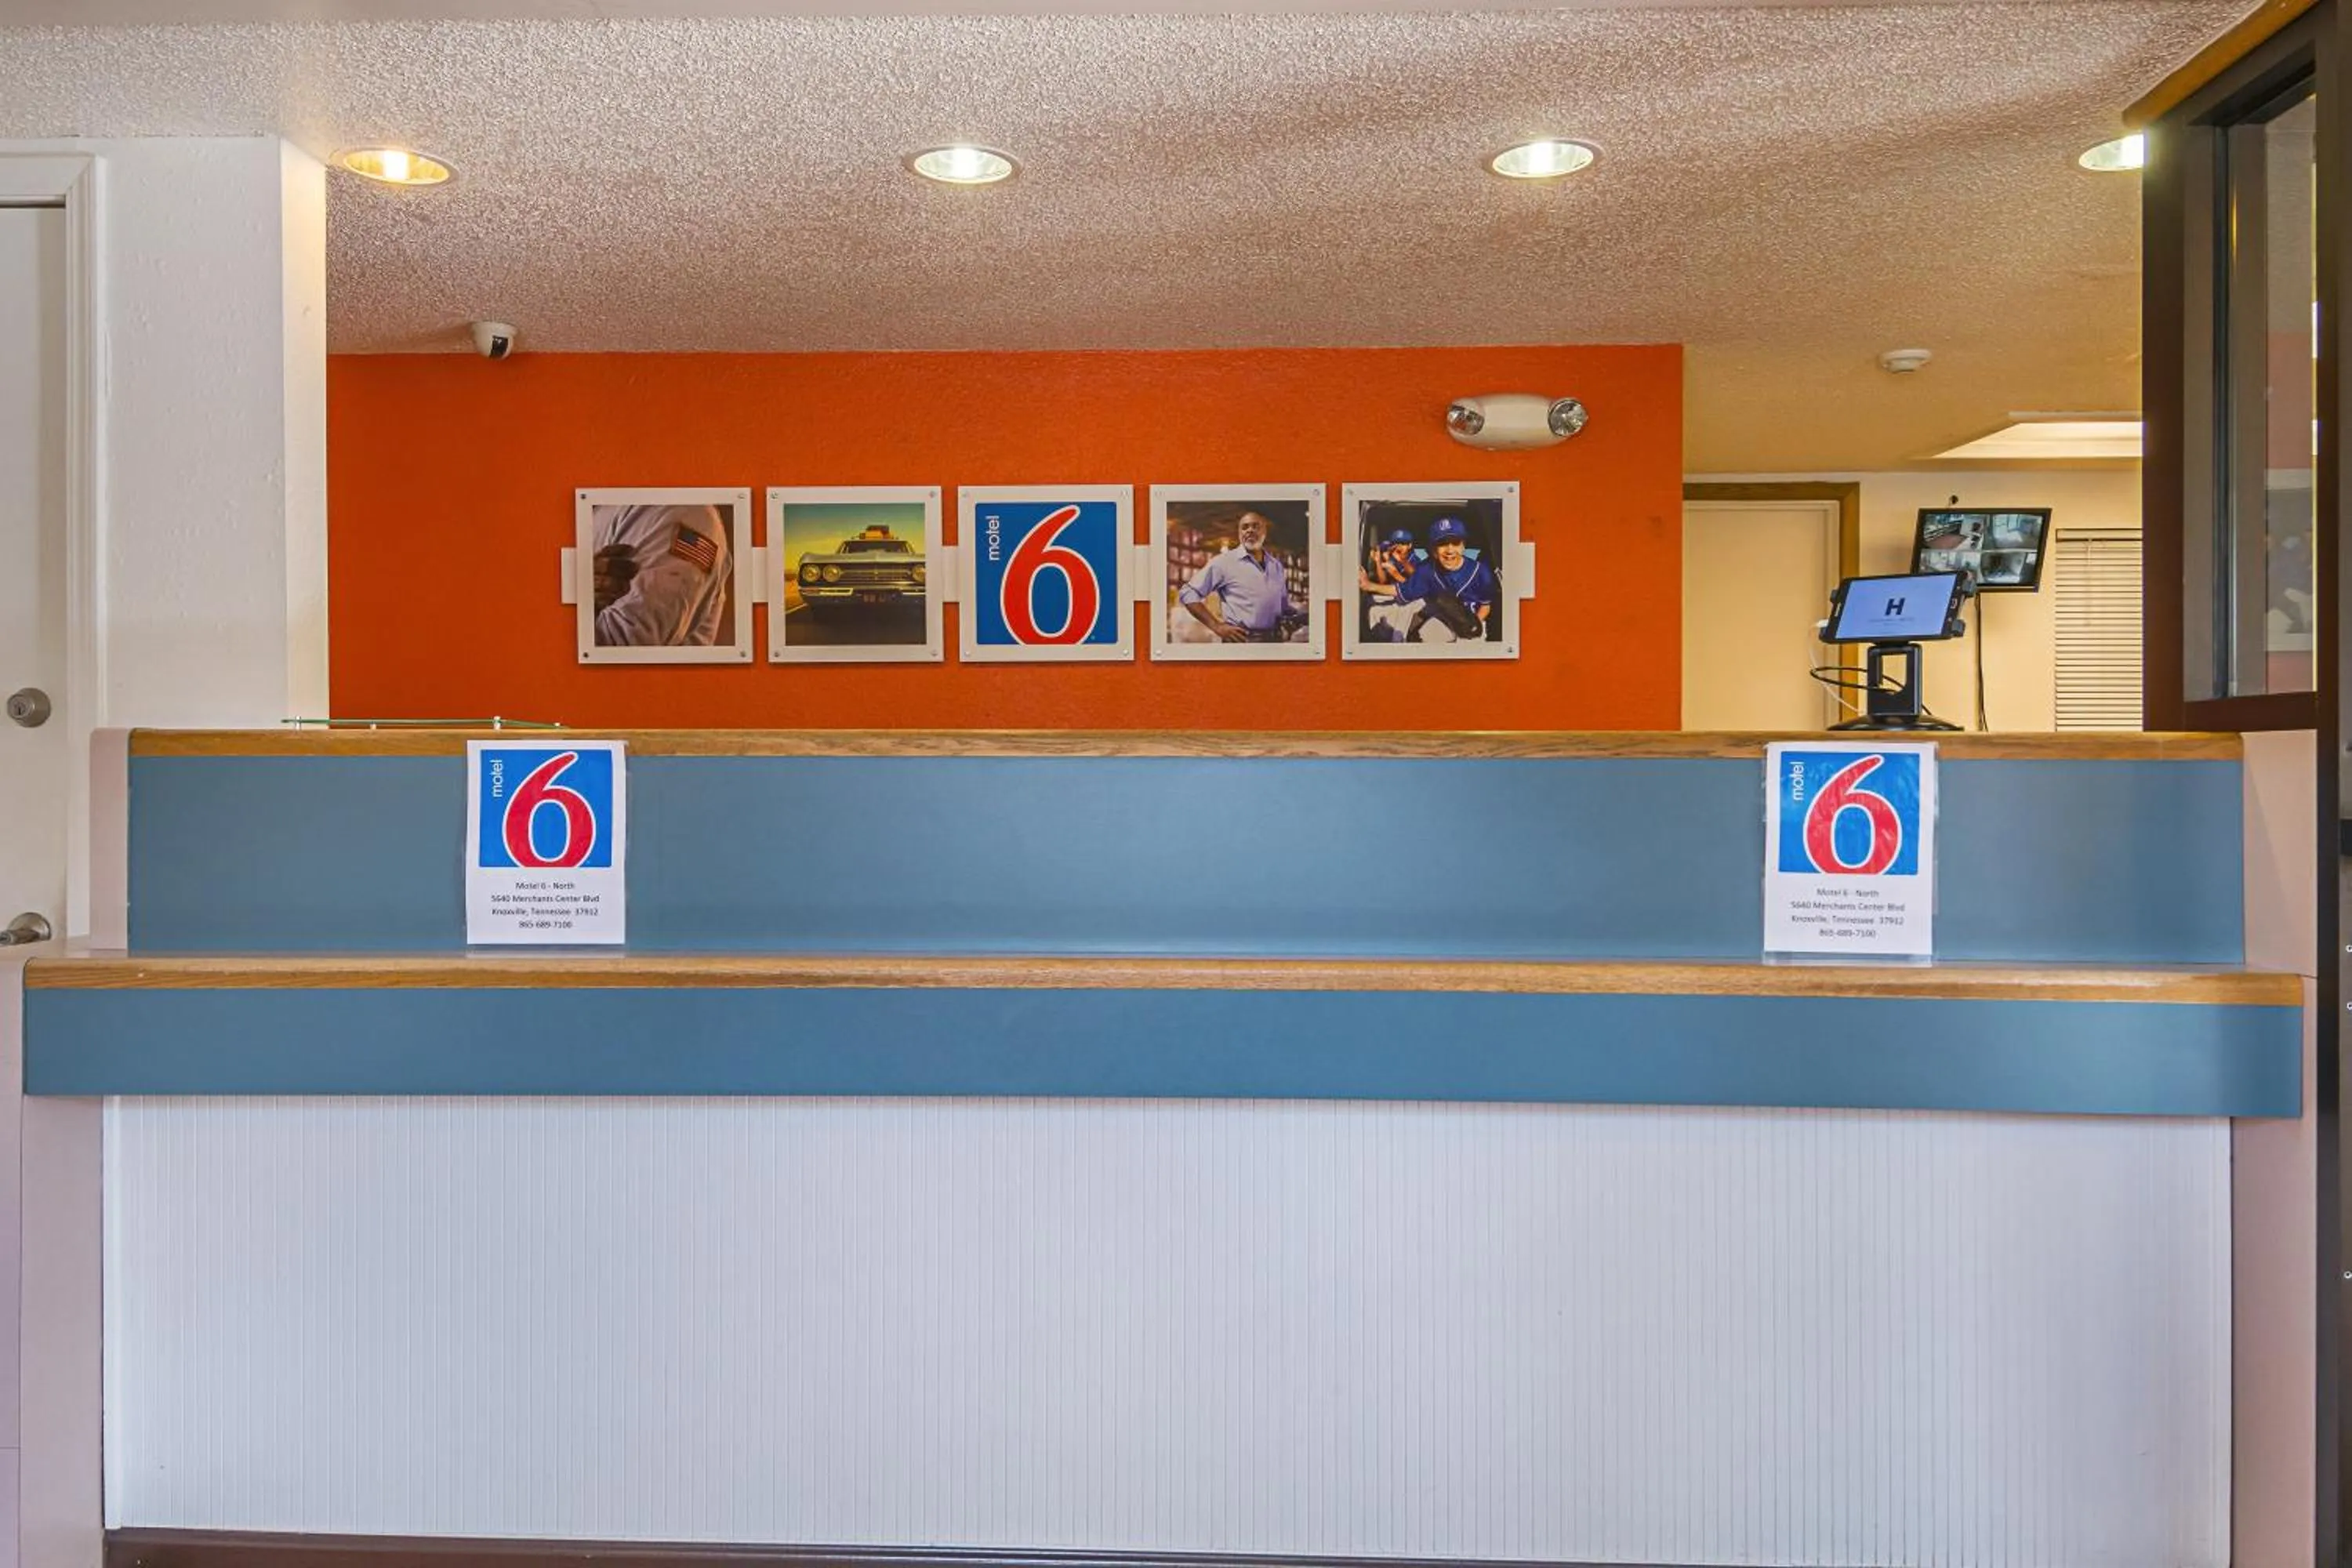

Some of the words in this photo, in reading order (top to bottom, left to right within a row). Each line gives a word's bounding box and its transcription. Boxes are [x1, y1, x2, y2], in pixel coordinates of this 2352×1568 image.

[985, 514, 1000, 561] motel
[1000, 504, 1101, 646] 6
[1885, 597, 1905, 615] H
[489, 759, 503, 798] motel
[502, 751, 597, 868] 6
[1790, 761, 1804, 801] motel
[1802, 753, 1903, 876] 6
[1813, 902, 1856, 910] Merchants
[1887, 903, 1905, 912] Blvd
[1832, 916, 1874, 924] Tennessee
